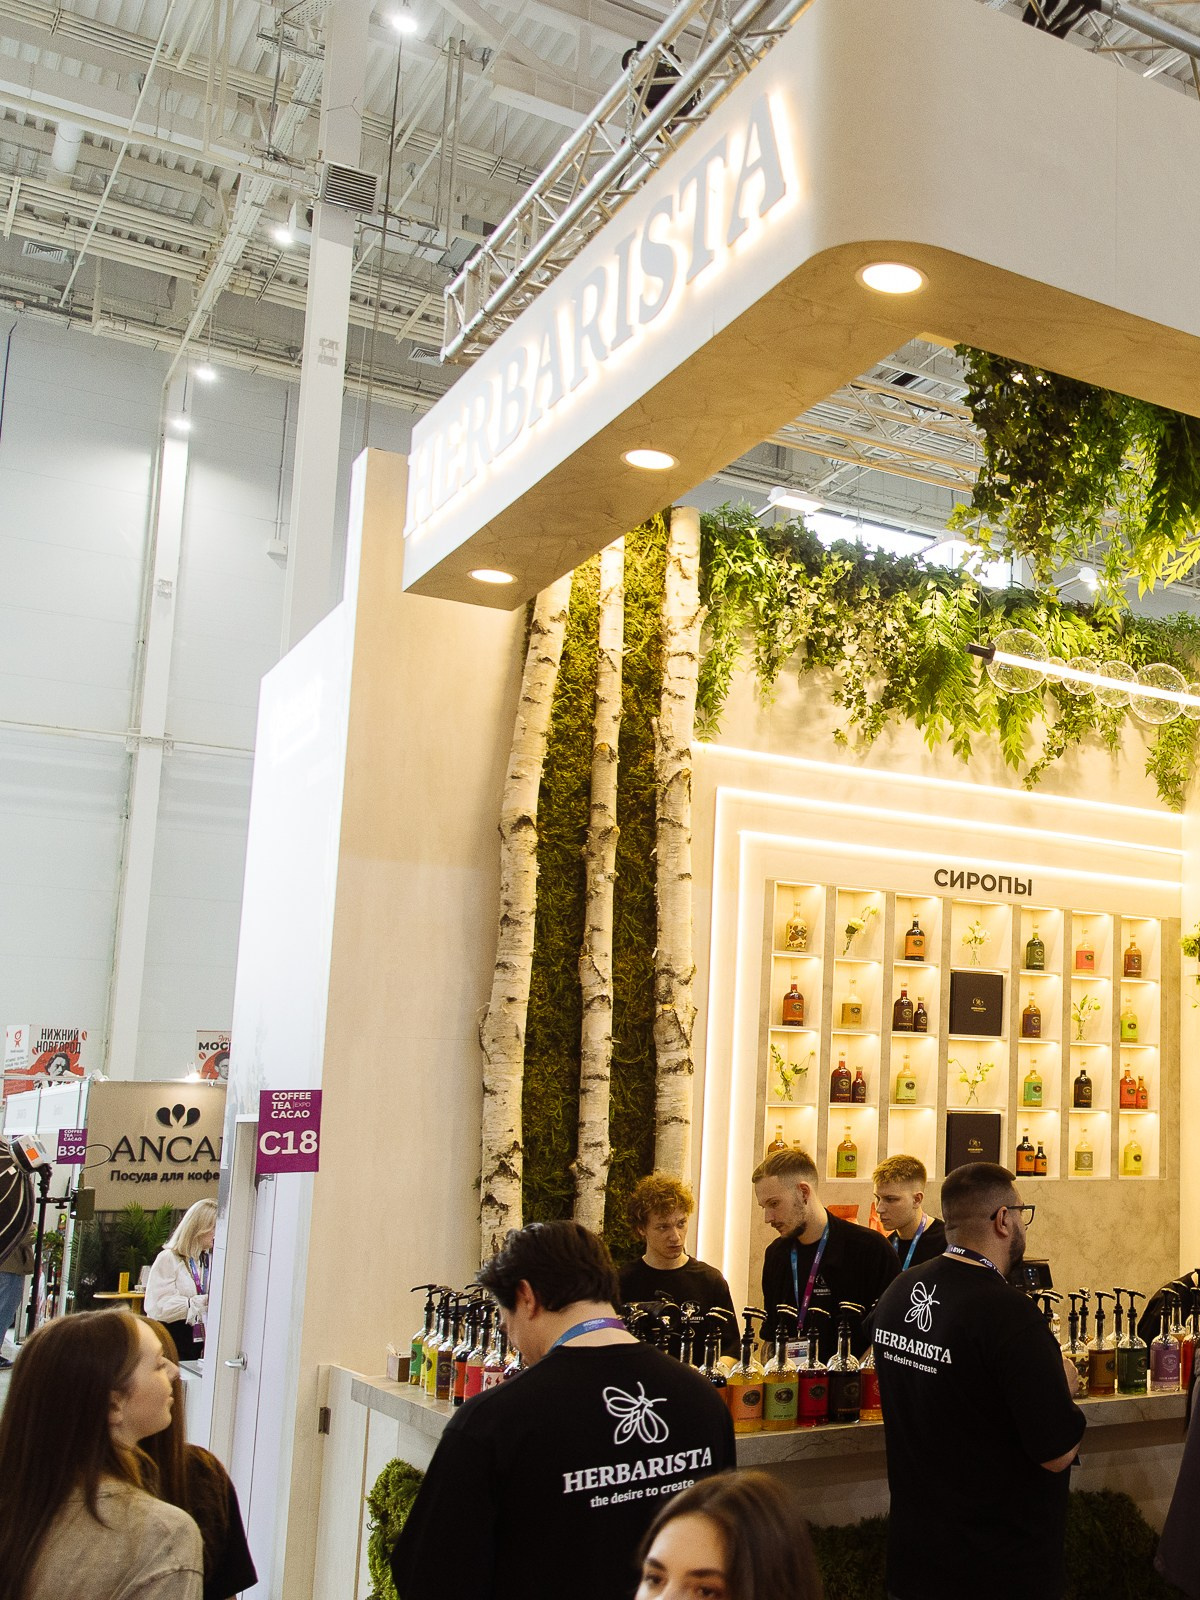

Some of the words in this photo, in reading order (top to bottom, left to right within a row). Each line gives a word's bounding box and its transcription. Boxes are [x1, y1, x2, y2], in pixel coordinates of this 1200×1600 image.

[403, 92, 787, 541] HERBARISTA
[933, 868, 1034, 897] СИРОПЫ
[41, 1027, 79, 1041] НИЖНИЙ
[36, 1040, 81, 1054] НОВГОРОД
[271, 1092, 312, 1101] COFFEE
[271, 1101, 291, 1110] TEA
[271, 1110, 311, 1119] CACAO
[109, 1135, 223, 1162] ANCA
[259, 1129, 318, 1156] C18
[110, 1170, 158, 1184] Посуда
[161, 1172, 184, 1182] для
[188, 1170, 220, 1183] кофе
[874, 1328, 953, 1364] HERBARISTA
[883, 1351, 893, 1361] the
[893, 1354, 913, 1367] desire
[912, 1359, 919, 1369] to
[918, 1363, 938, 1375] create
[562, 1447, 712, 1494] HERBARISTA
[590, 1494, 608, 1508] the
[610, 1487, 643, 1505] desire
[645, 1485, 658, 1497] to
[661, 1478, 695, 1495] create
